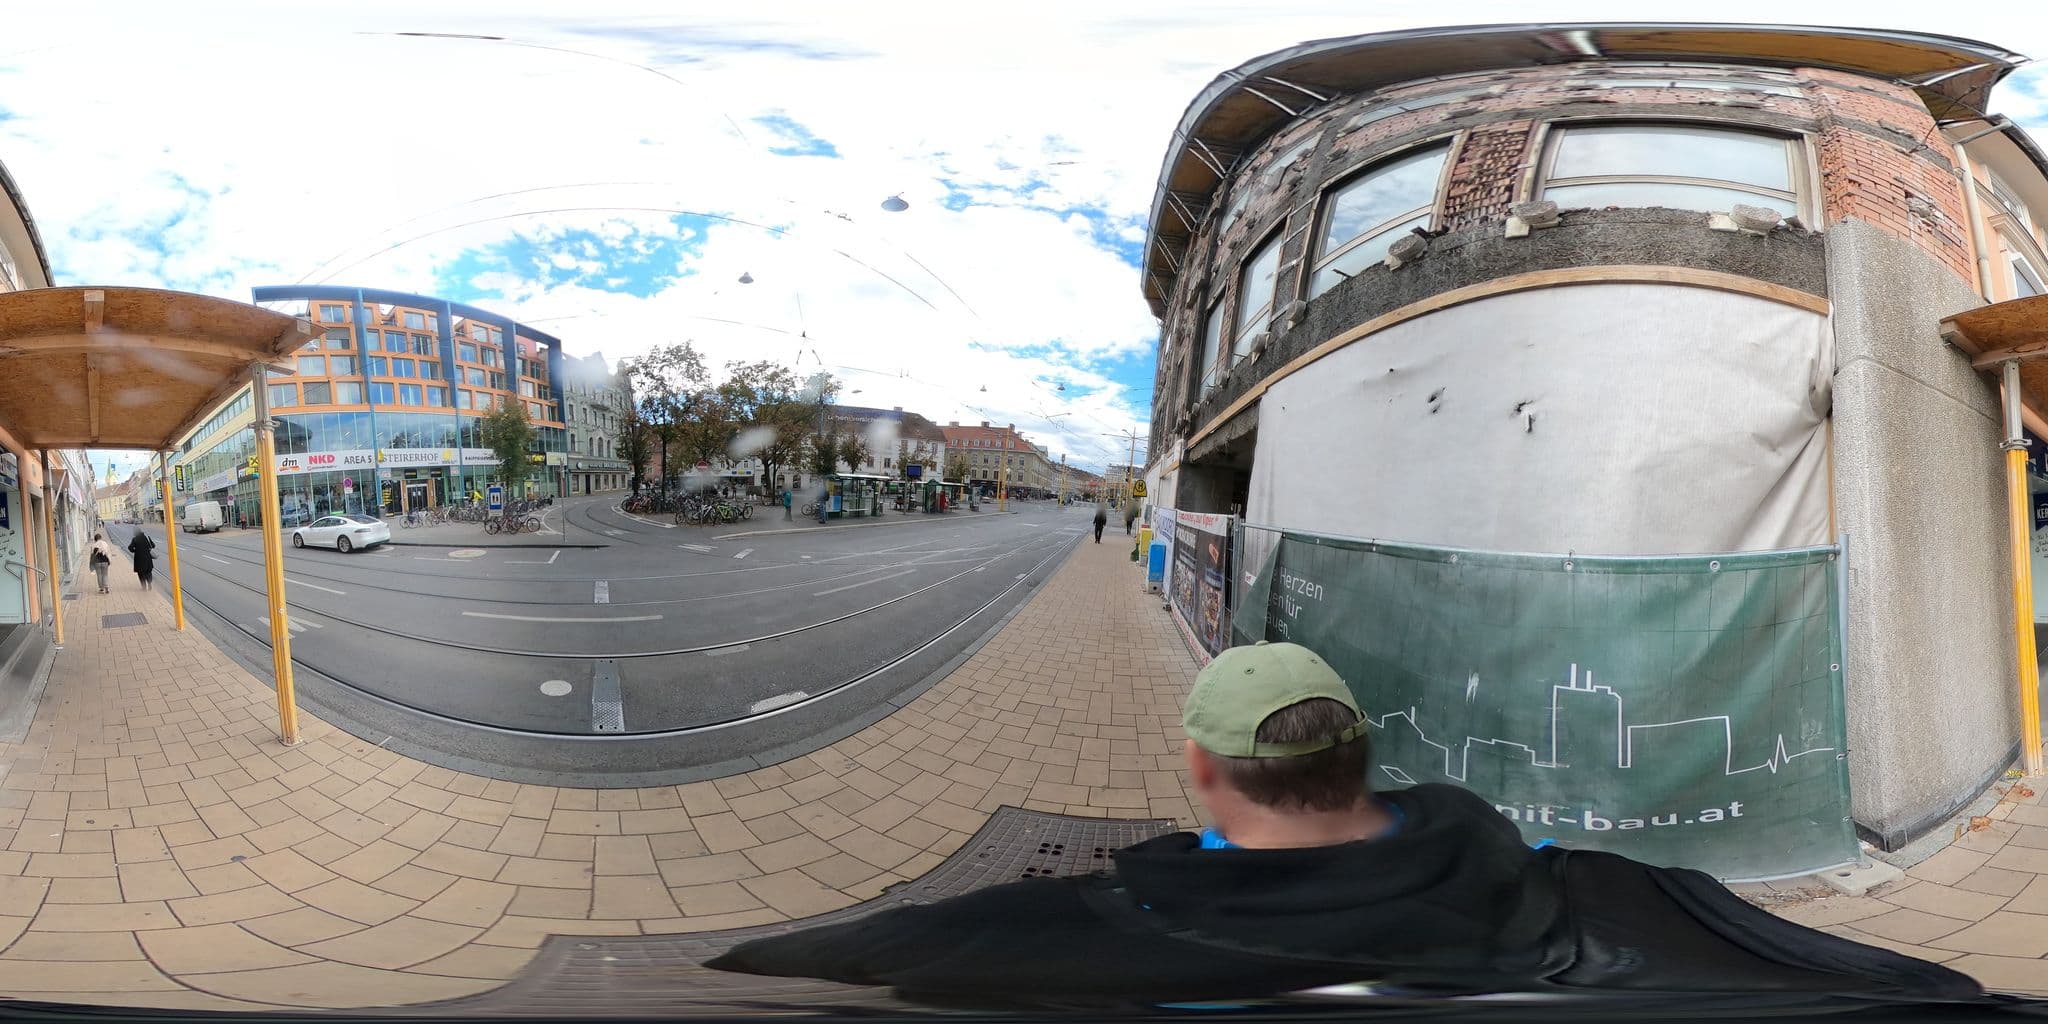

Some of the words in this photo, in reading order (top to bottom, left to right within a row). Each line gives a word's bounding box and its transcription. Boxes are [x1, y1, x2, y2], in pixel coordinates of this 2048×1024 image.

[281, 457, 298, 467] dm
[308, 454, 336, 465] NKD
[343, 455, 366, 465] AREA
[383, 453, 439, 463] STEIRERHOF
[1279, 566, 1324, 602] Herzen
[1285, 594, 1303, 620] für
[1495, 800, 1745, 832] nit-bau.at
